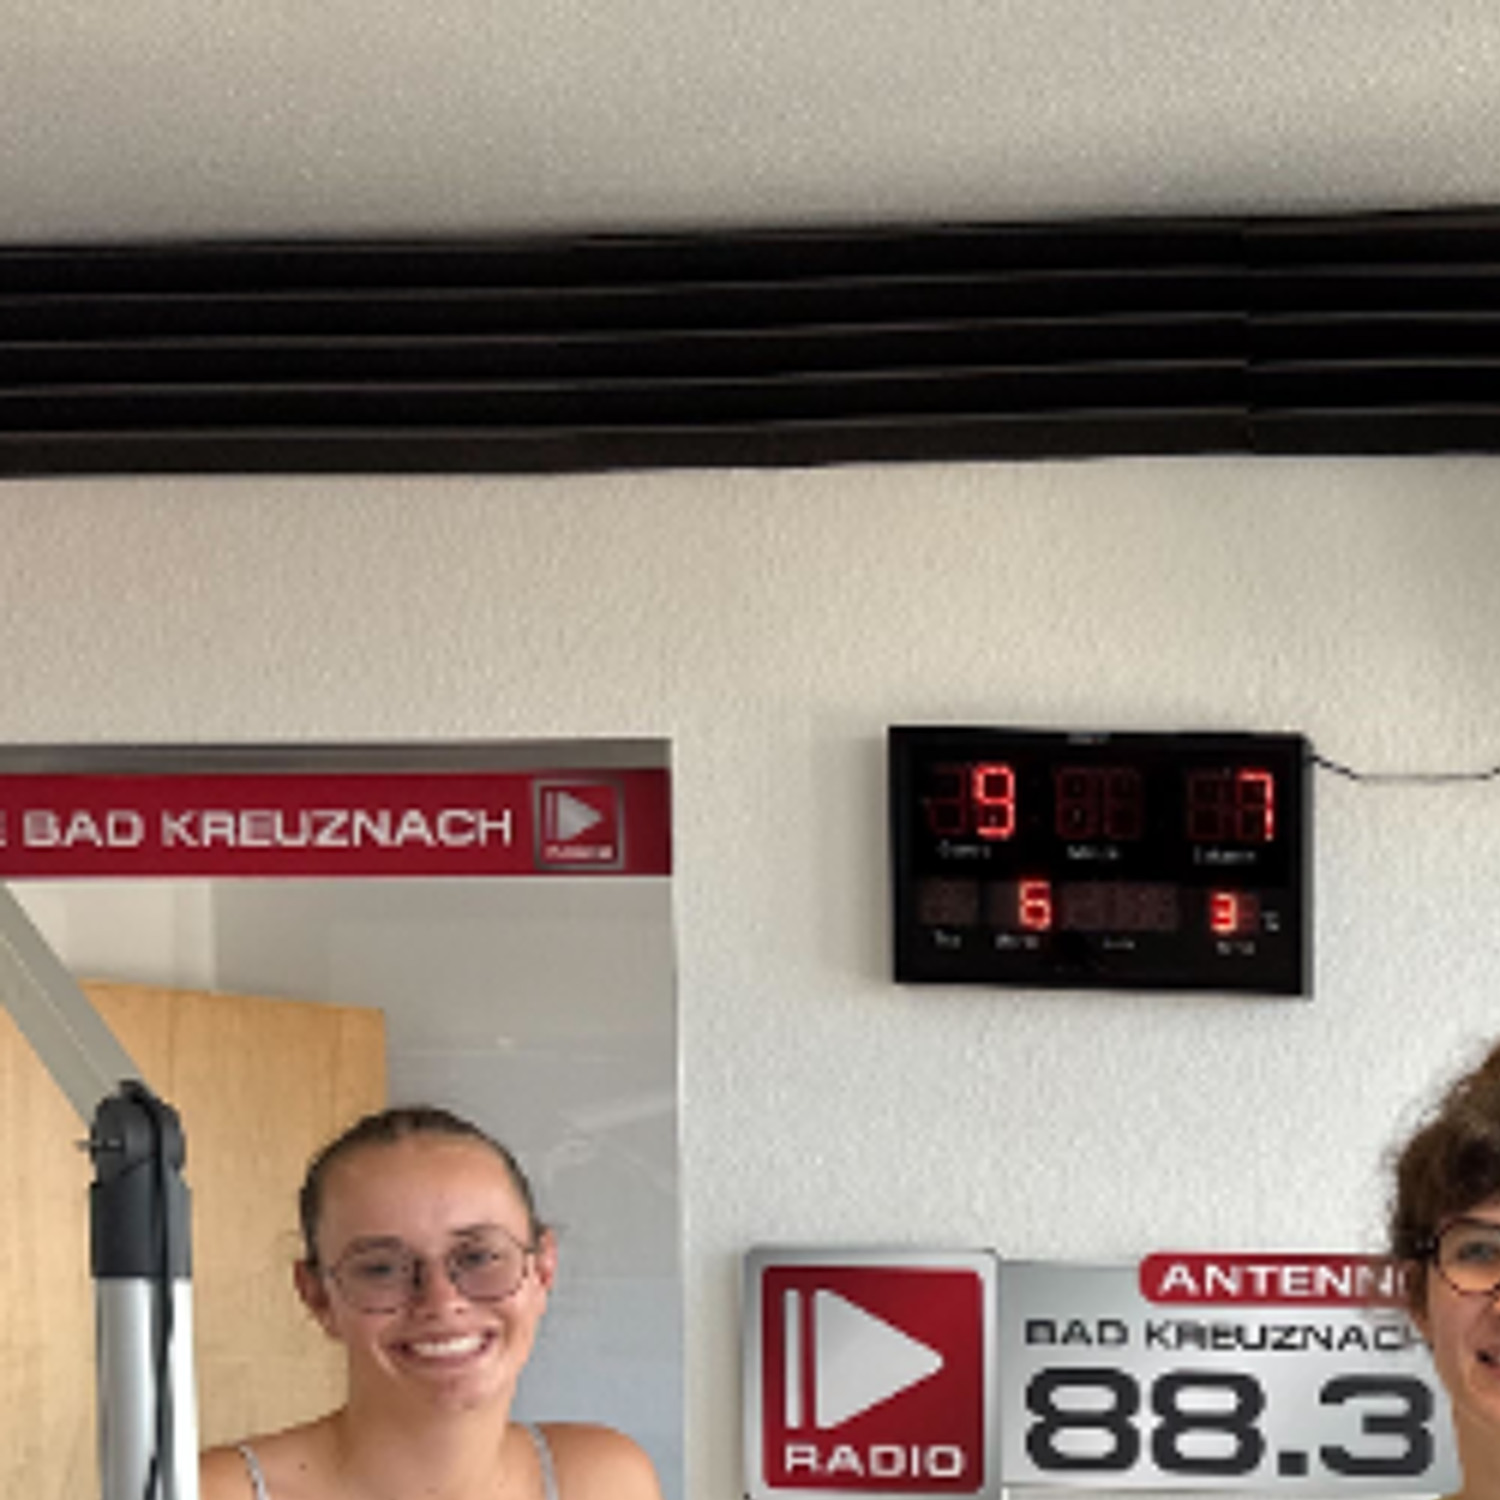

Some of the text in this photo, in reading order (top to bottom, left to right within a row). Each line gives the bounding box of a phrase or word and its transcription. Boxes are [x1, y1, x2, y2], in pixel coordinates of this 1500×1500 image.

[976, 763, 1274, 841] 9 7
[23, 809, 144, 847] BAD
[162, 809, 512, 847] KREUZNACH
[1019, 880, 1052, 929] 6
[1210, 892, 1237, 933] 3
[1158, 1264, 1405, 1299] ANTENN
[1025, 1320, 1128, 1347] BAD
[1025, 1368, 1434, 1477] 88.3
[784, 1444, 965, 1478] RADIO
